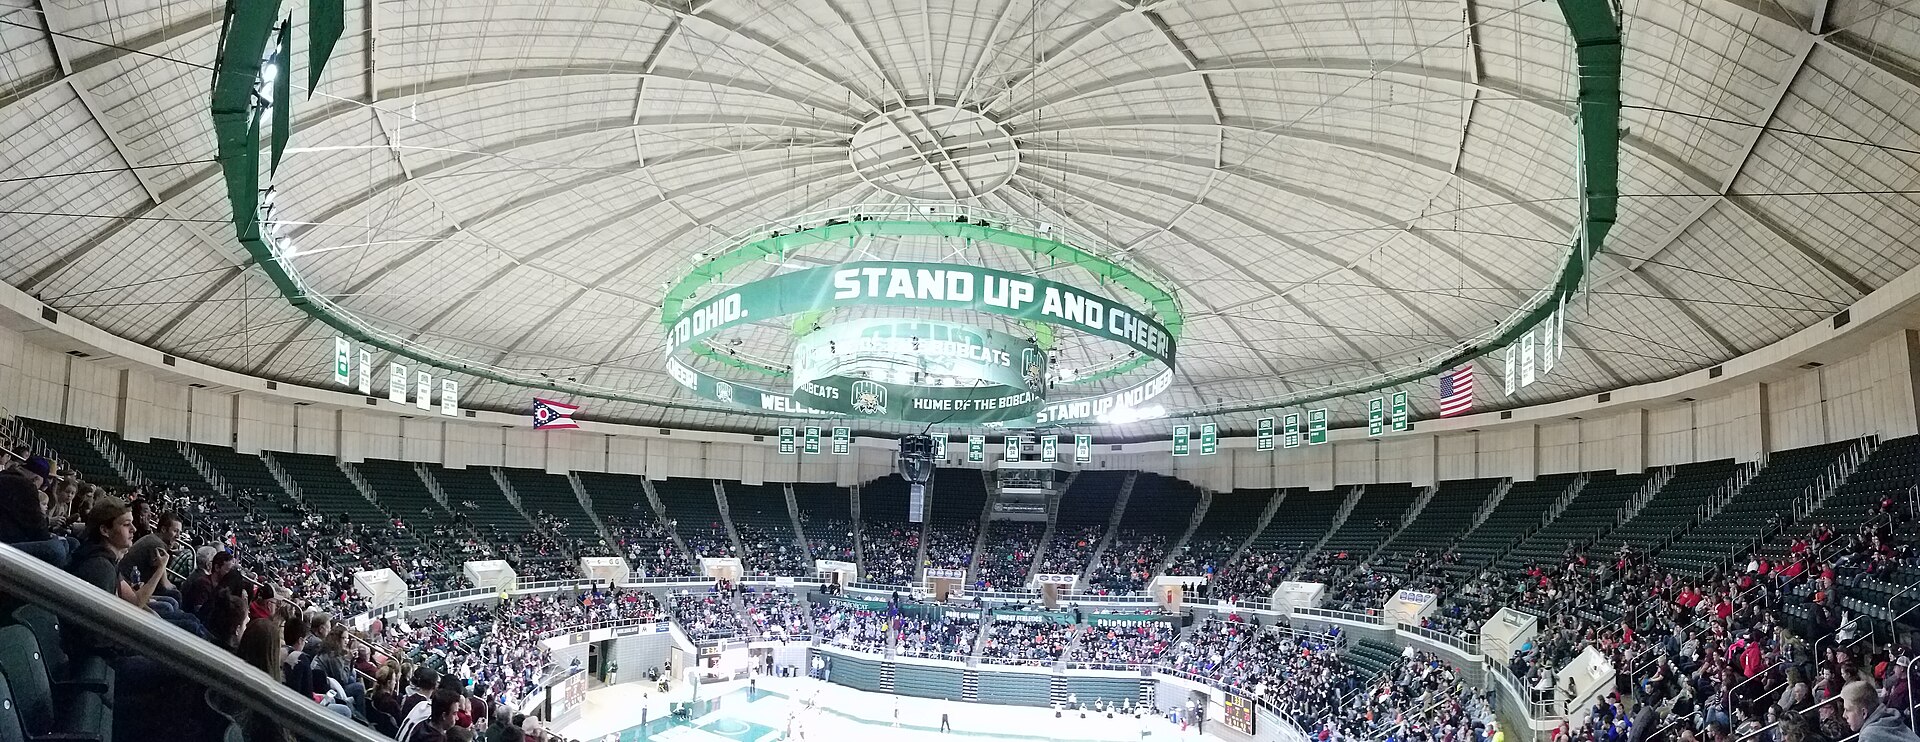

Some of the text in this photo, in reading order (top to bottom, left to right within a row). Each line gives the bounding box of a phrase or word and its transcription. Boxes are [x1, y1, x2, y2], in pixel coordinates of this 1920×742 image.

[675, 317, 691, 347] TO
[693, 293, 749, 336] OHIO.
[834, 267, 1169, 359] STAND UP AND CHEER!
[801, 382, 839, 399] BOBCATS
[914, 398, 949, 411] HOME
[954, 399, 971, 411] OF
[974, 397, 997, 411] THE
[1036, 401, 1090, 423] STAND
[1093, 397, 1112, 415] UP
[1115, 386, 1143, 411] AND
